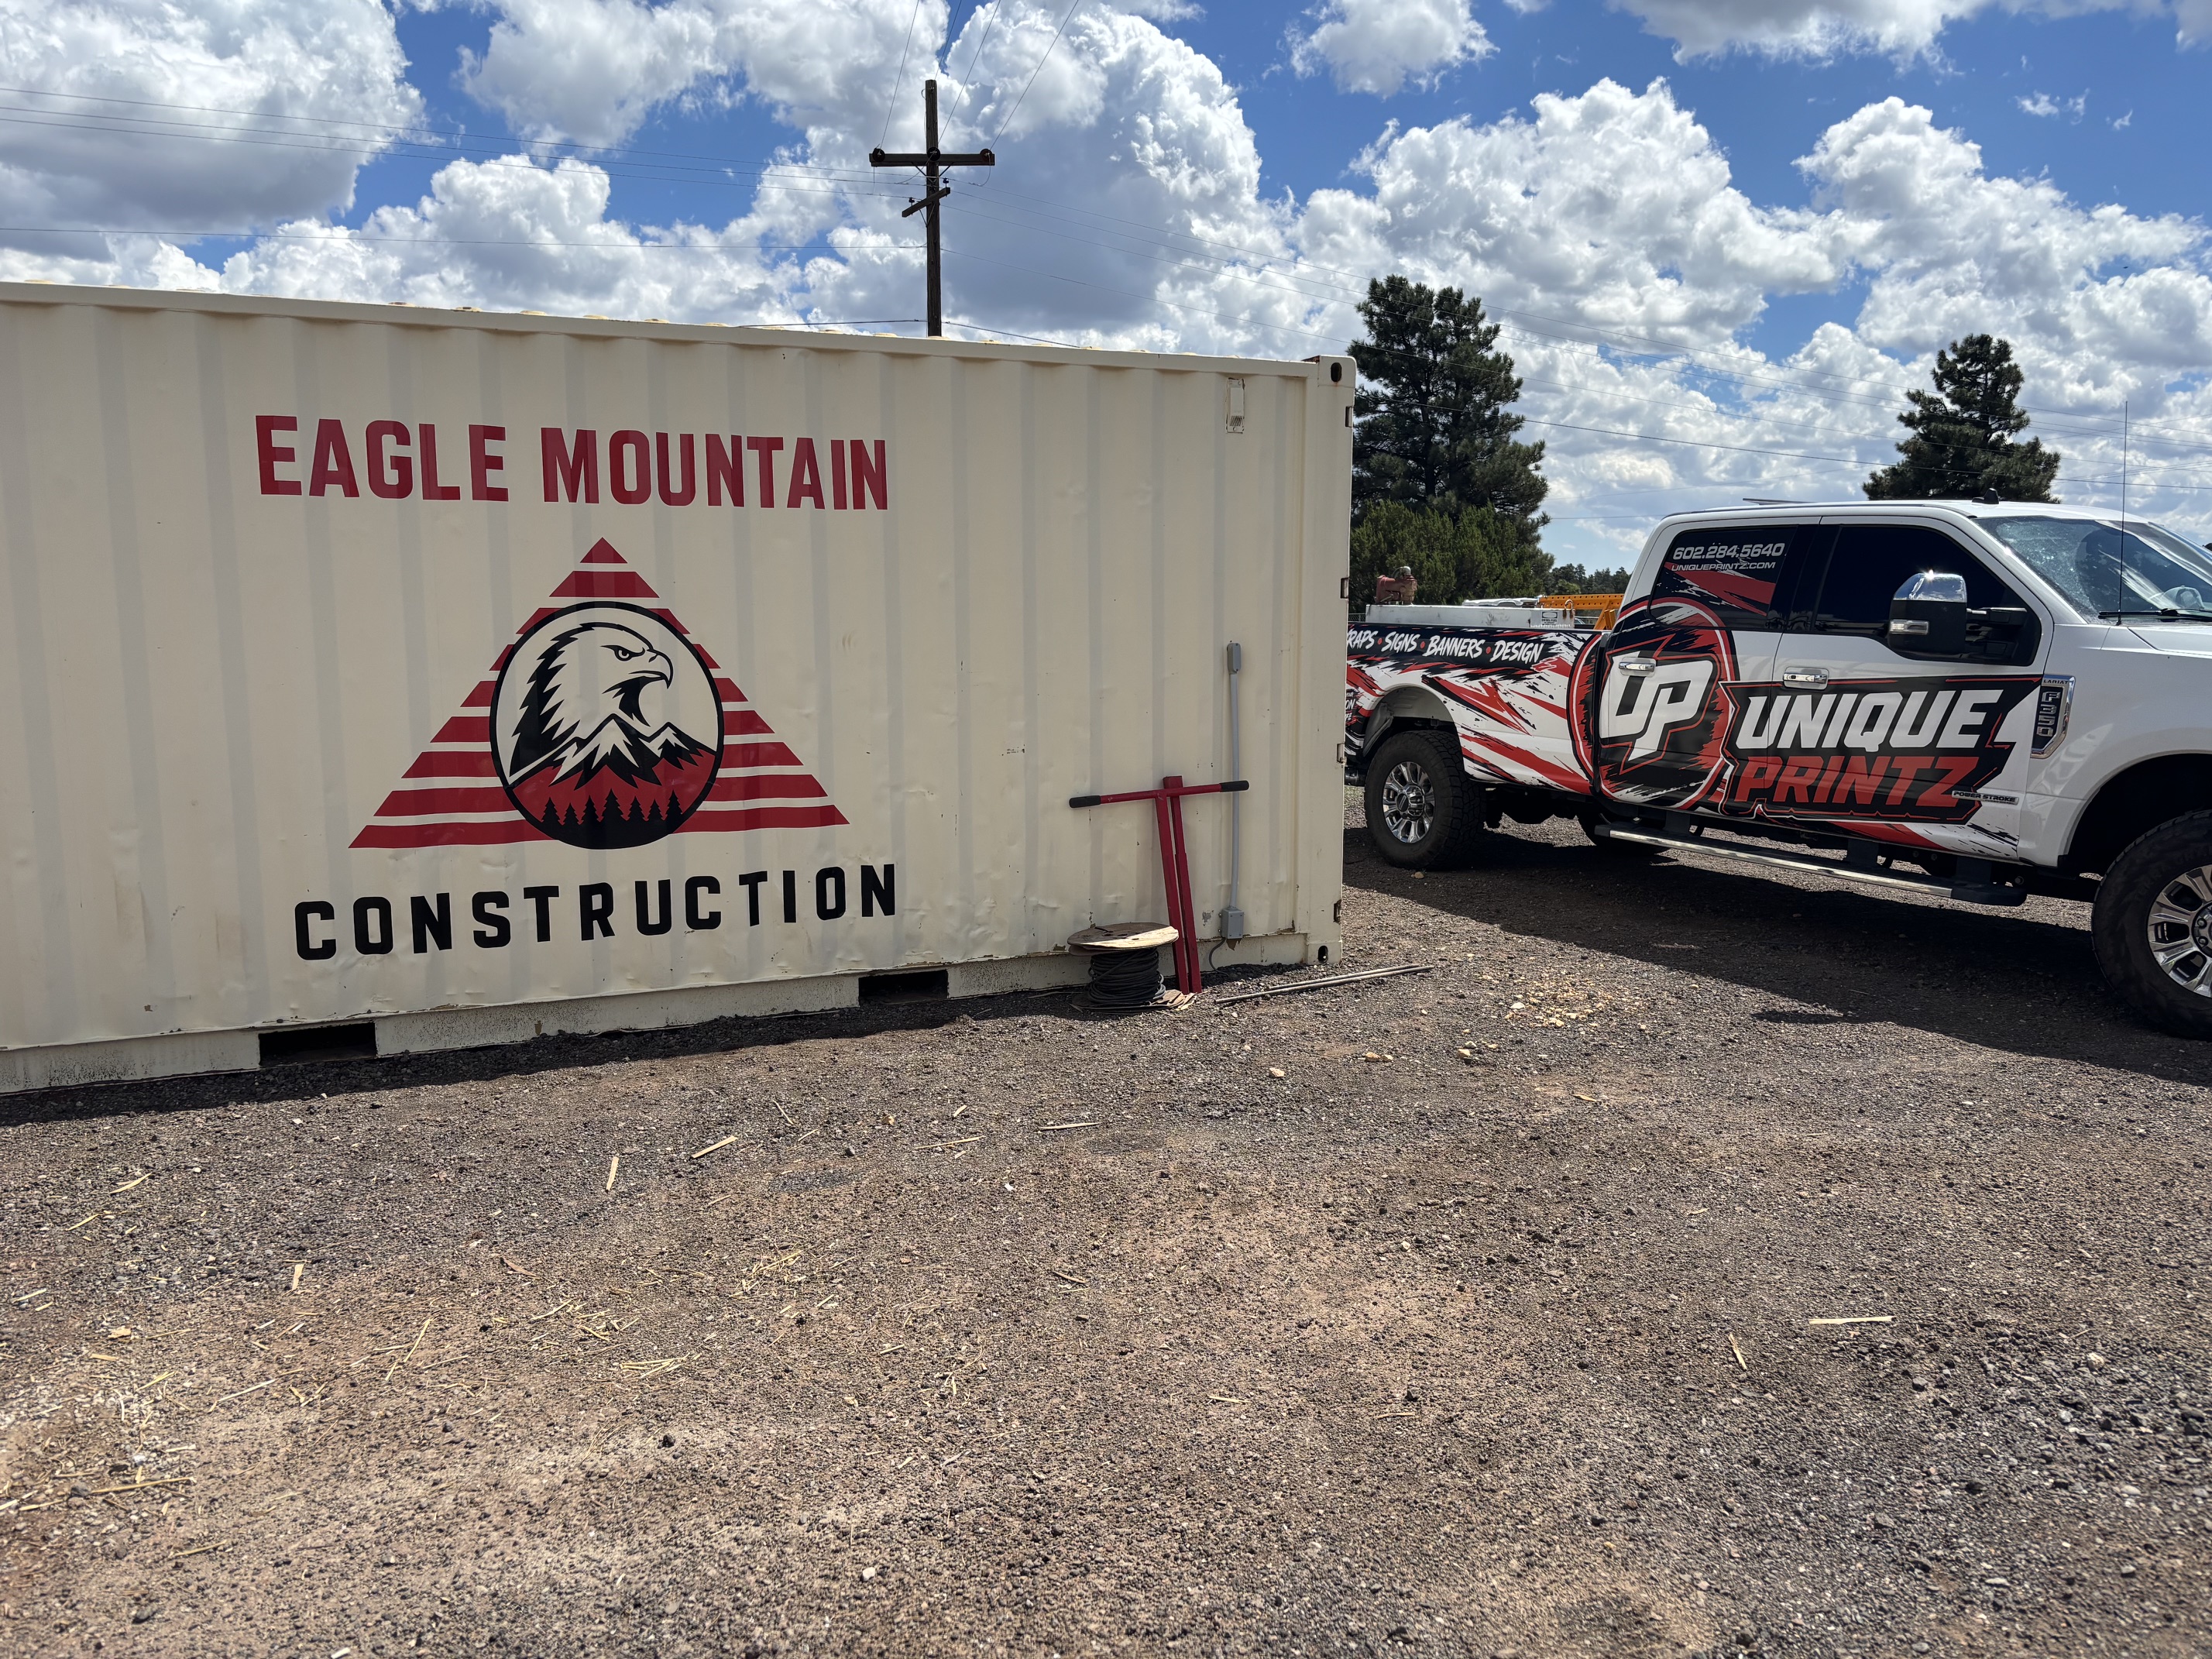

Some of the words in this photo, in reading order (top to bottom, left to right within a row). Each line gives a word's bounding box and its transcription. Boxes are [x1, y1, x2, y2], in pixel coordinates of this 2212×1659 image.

[256, 414, 509, 503] EAGLE
[541, 427, 888, 510] MOUNTAIN
[1671, 562, 1776, 572] UNIQUEPRINTZ.COM
[1673, 543, 1785, 560] 602.284.5640
[1346, 628, 1379, 649] RAPS
[1381, 631, 1420, 653] SIGNS
[1422, 635, 1484, 658] BANNERS
[1489, 640, 1544, 664] DESIGN
[1345, 699, 1355, 710] ON
[1735, 689, 2004, 752] UNIQUE
[1733, 756, 1980, 807] PRINTZ
[294, 863, 896, 960] CONSTRUCTION
